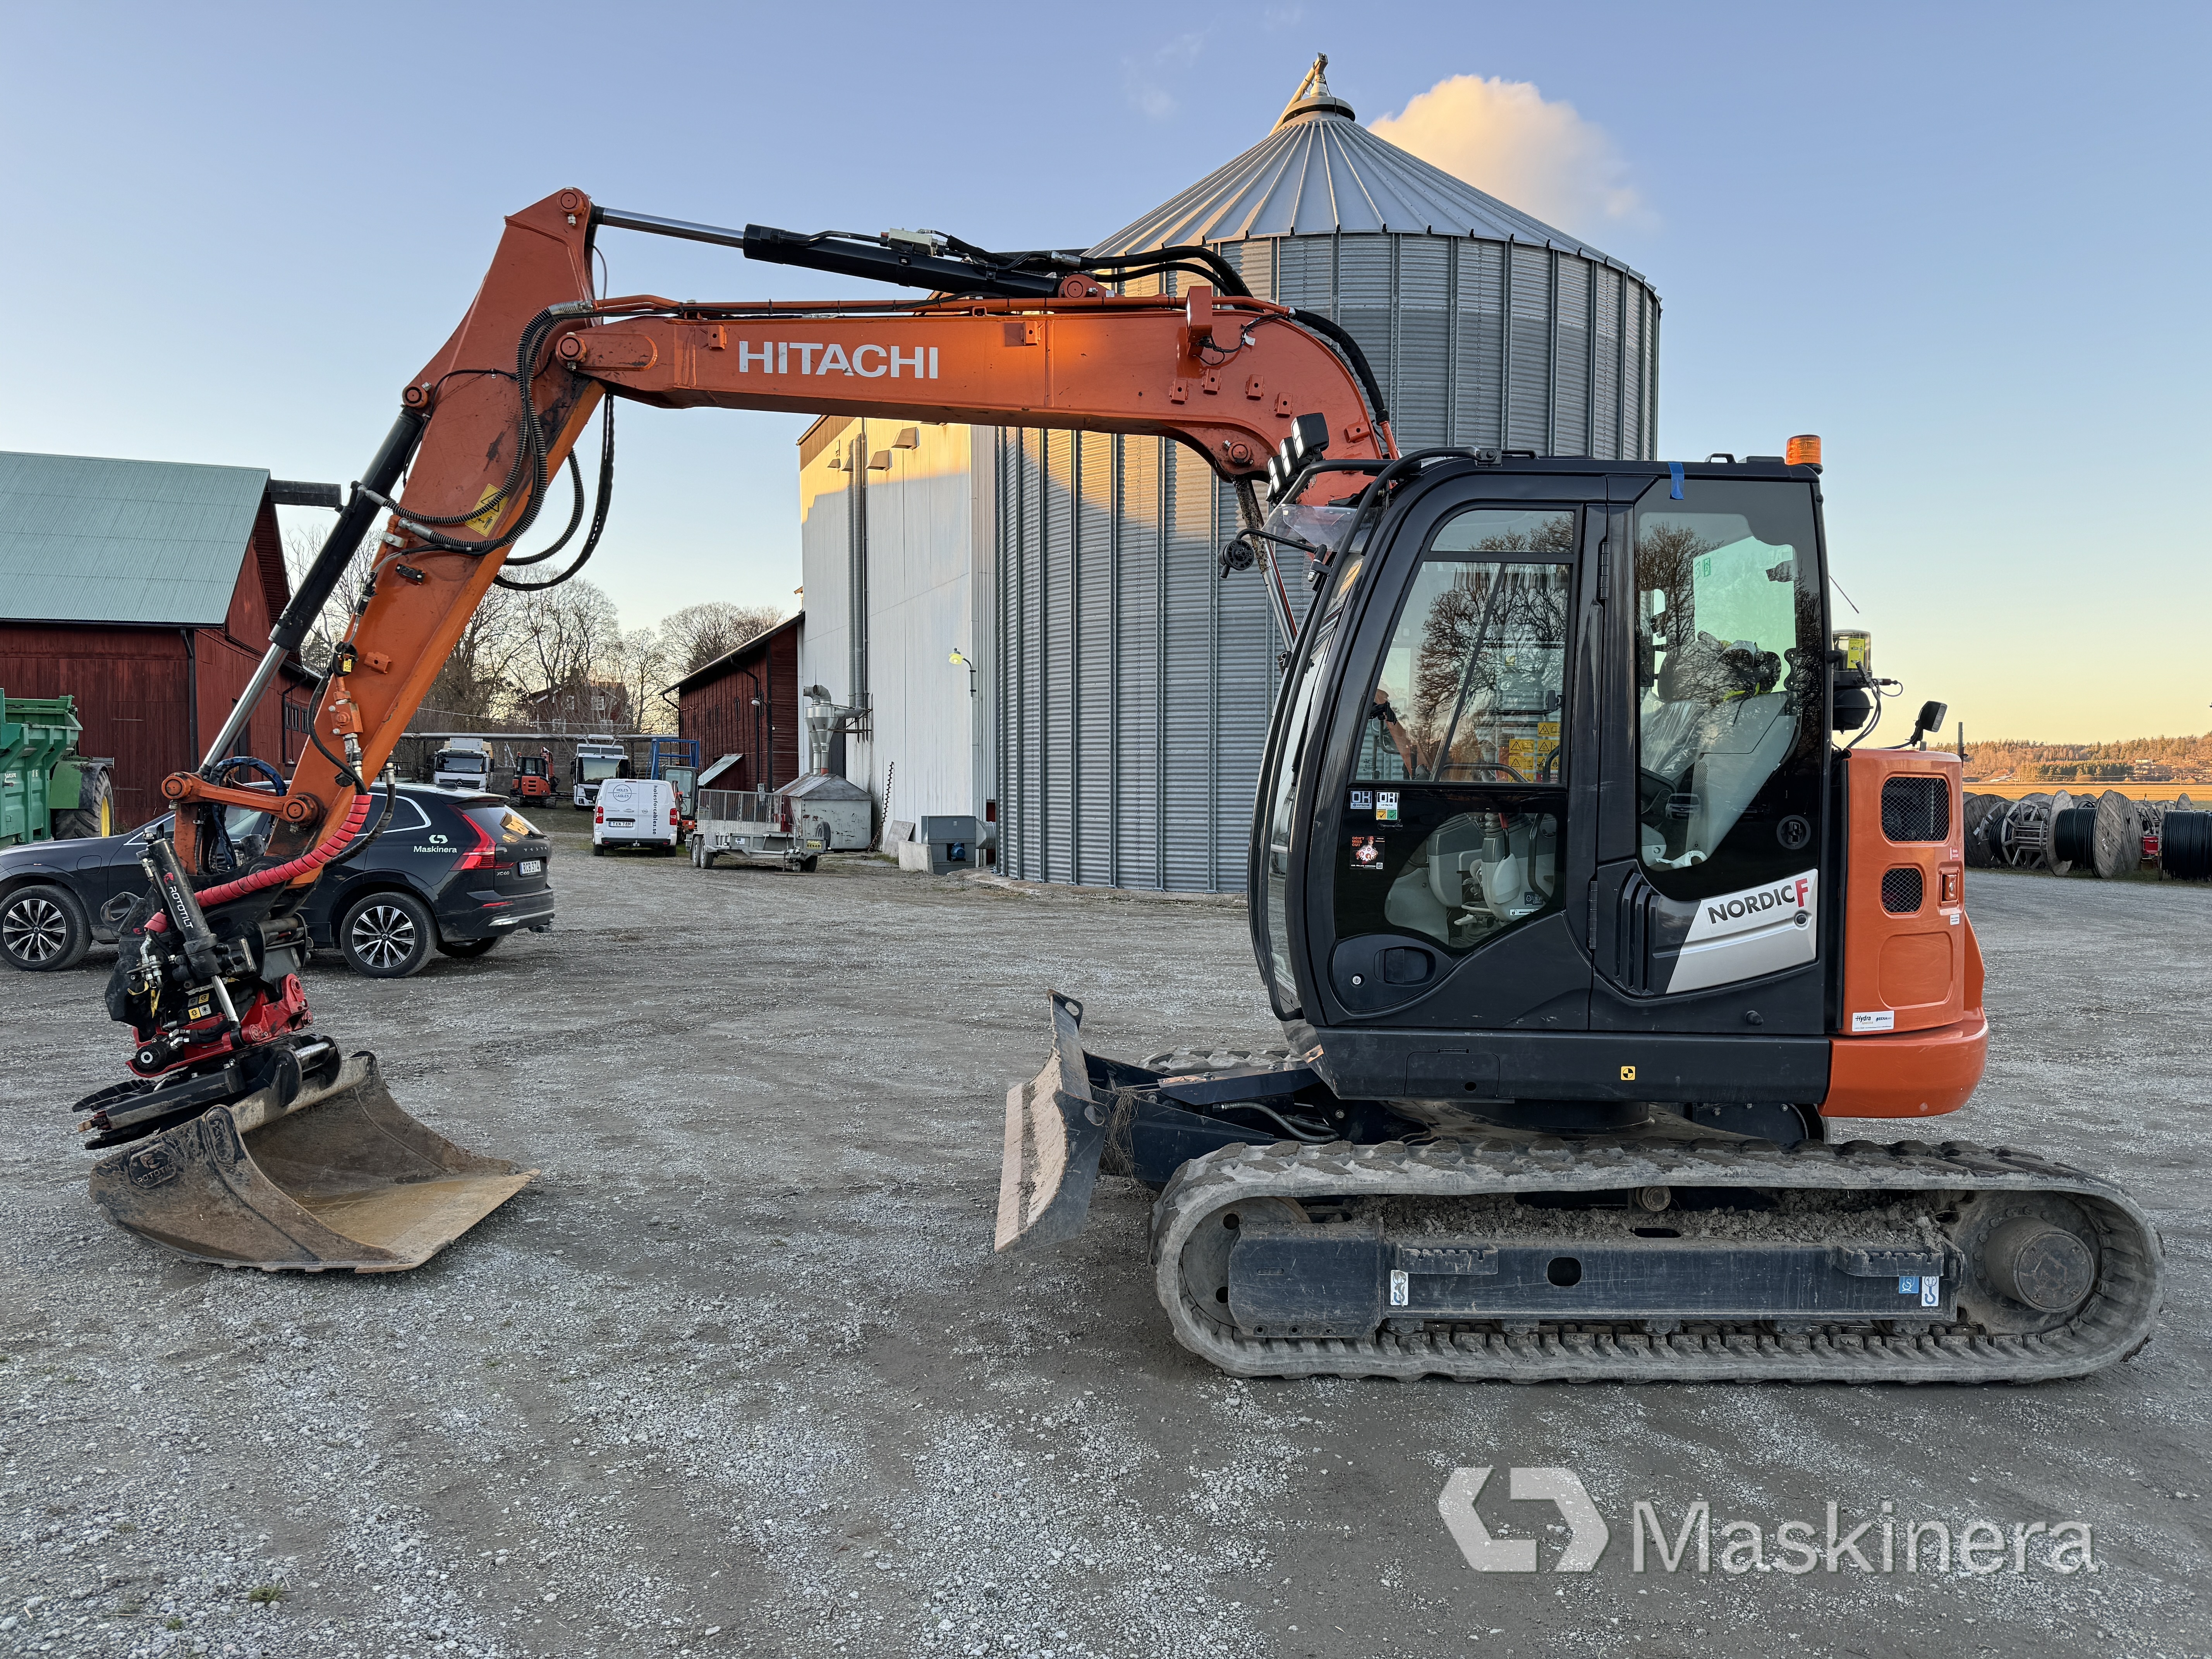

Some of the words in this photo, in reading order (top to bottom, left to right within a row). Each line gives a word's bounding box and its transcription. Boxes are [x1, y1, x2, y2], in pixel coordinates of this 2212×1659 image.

[739, 341, 938, 379] HITACHI
[1352, 792, 1370, 803] OK
[1379, 793, 1395, 802] OK
[523, 862, 531, 872] RCB
[169, 886, 194, 928] ROTOTILT
